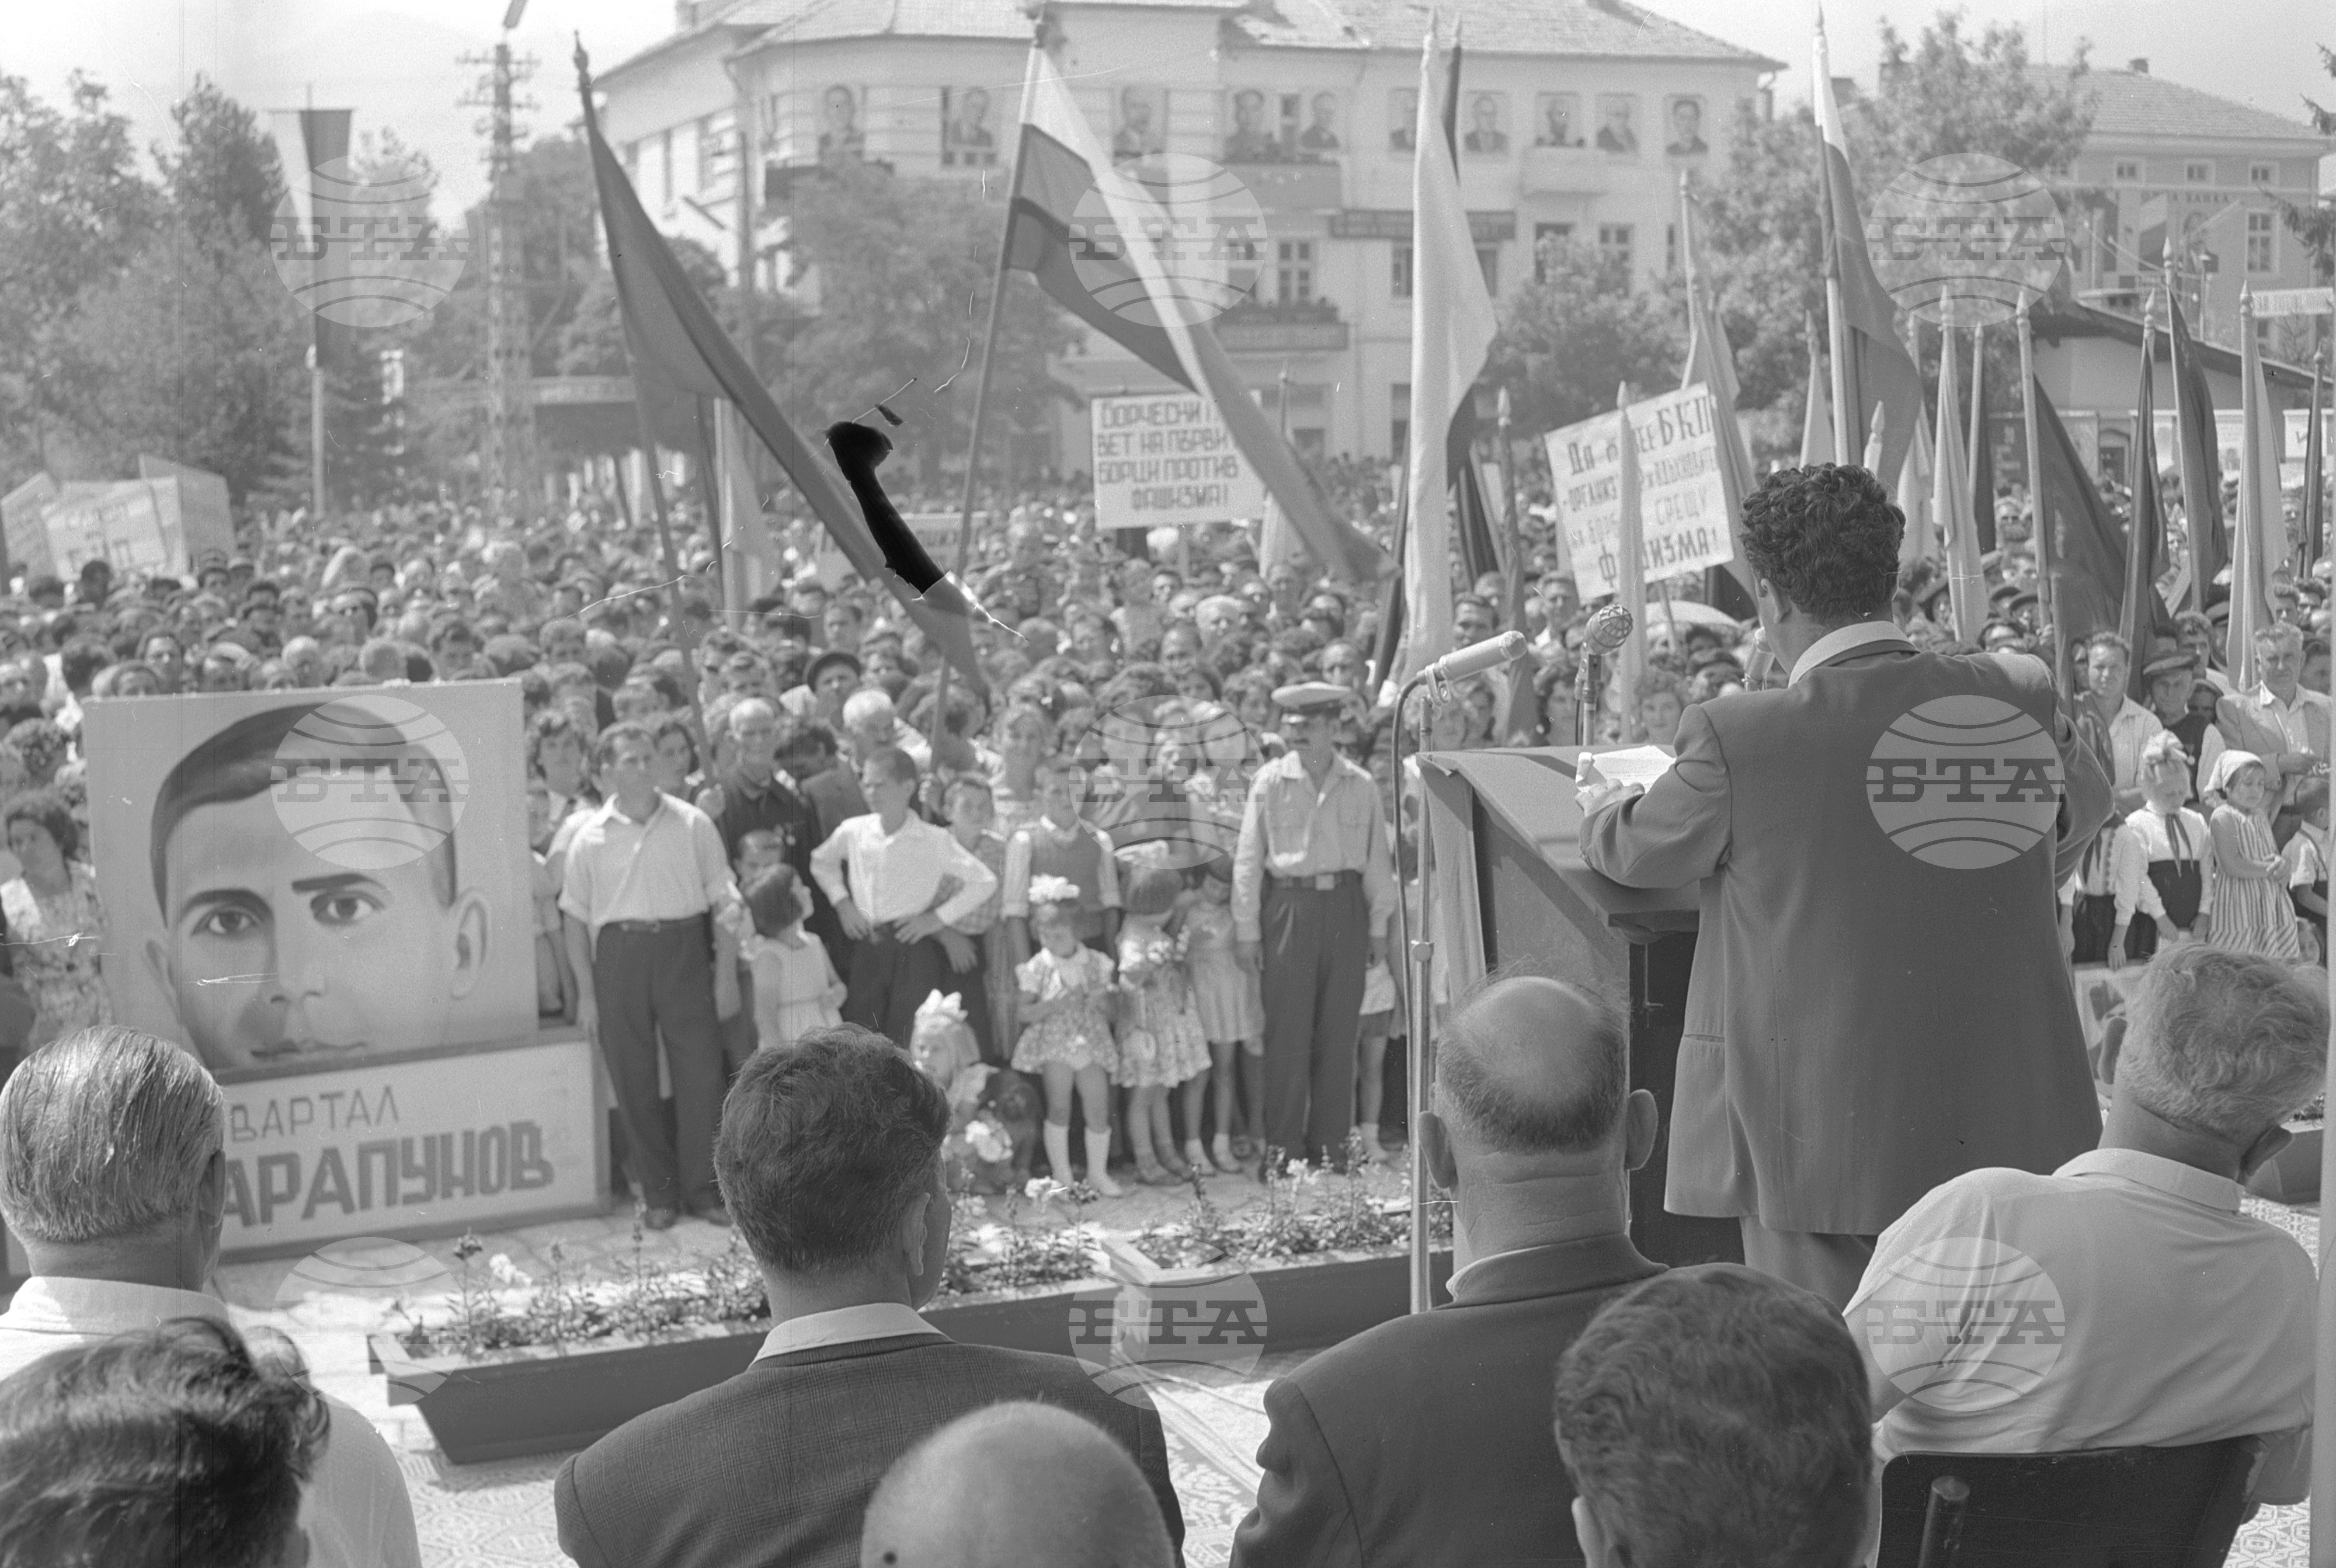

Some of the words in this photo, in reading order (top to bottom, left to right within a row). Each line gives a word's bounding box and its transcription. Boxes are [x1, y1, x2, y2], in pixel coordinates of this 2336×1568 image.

[1656, 396, 1711, 446] БКП
[1598, 527, 1718, 589] ФИЗМА!
[231, 1084, 399, 1143] ВАРТАЛ
[223, 1120, 554, 1228] АРАПУНОВ
